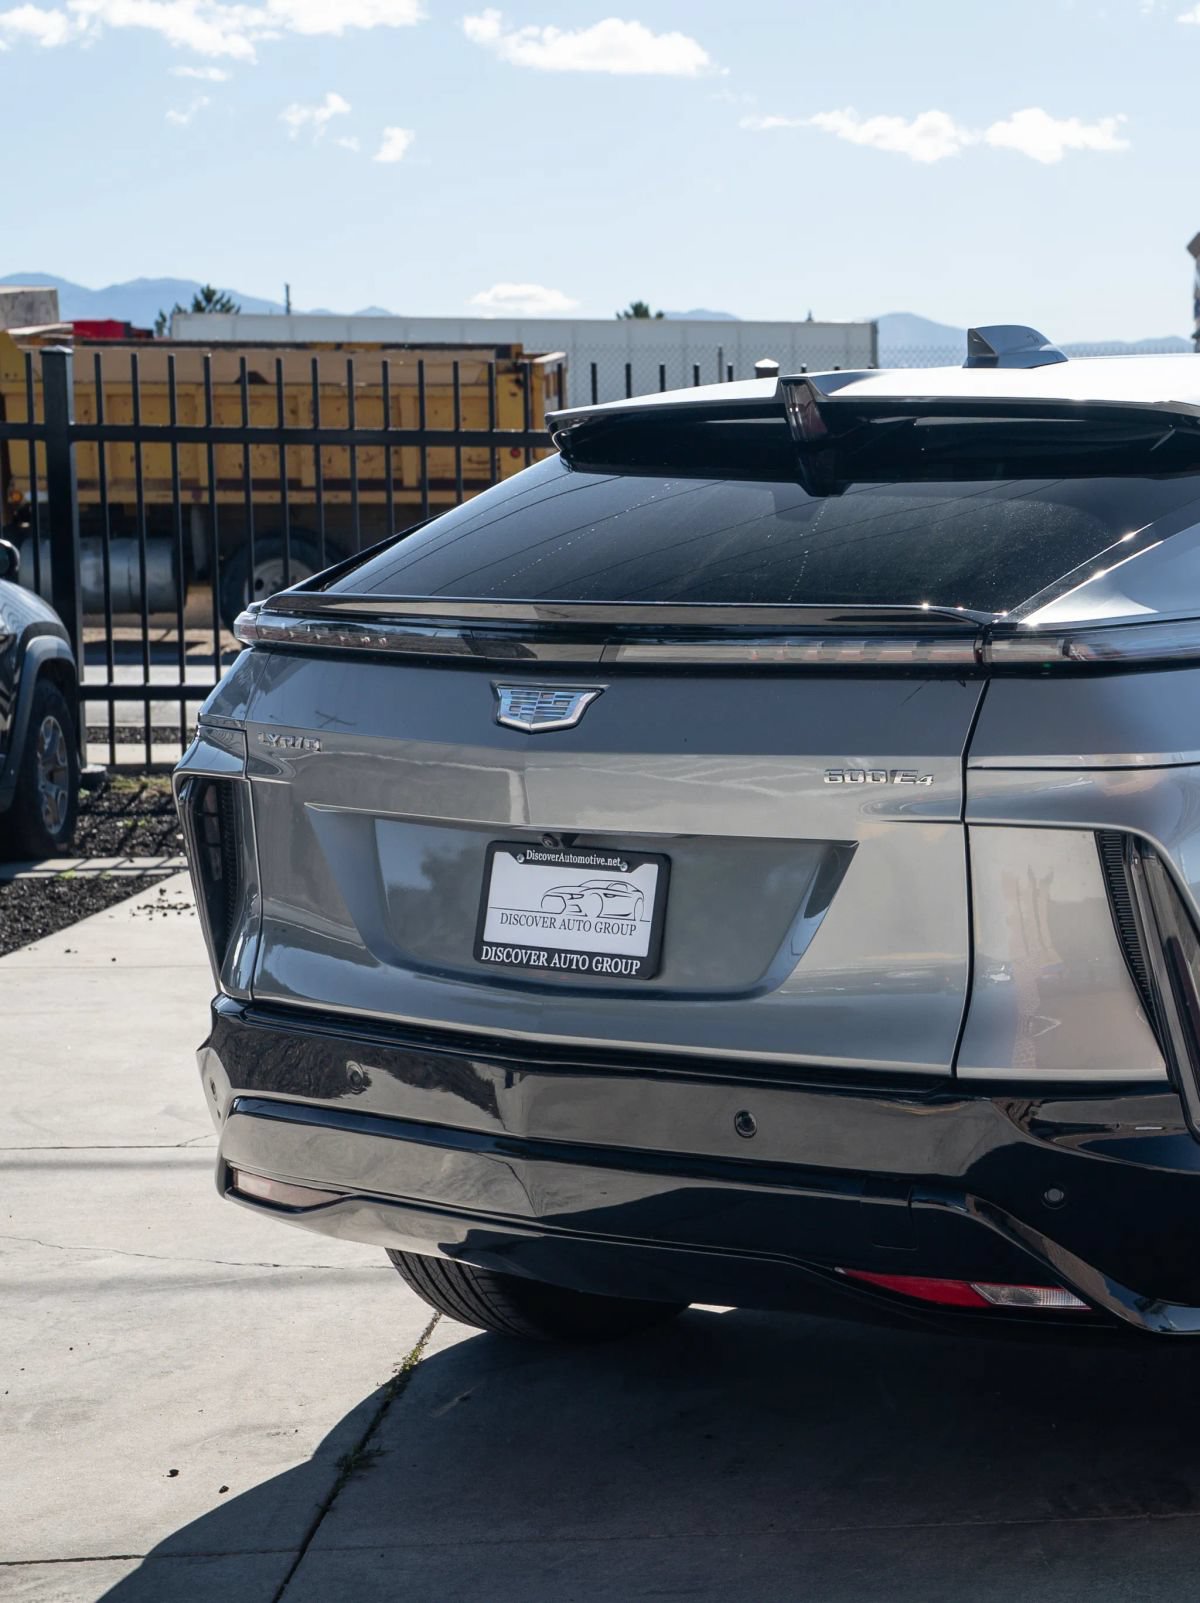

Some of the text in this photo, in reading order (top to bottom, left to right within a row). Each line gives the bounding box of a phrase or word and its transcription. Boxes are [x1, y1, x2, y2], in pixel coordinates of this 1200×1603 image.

[526, 850, 621, 867] DiscoverAutomotive.net
[500, 913, 637, 936] DISCOVER AUTO GROUP
[481, 945, 641, 975] DISCOVER AUTO GROUP
